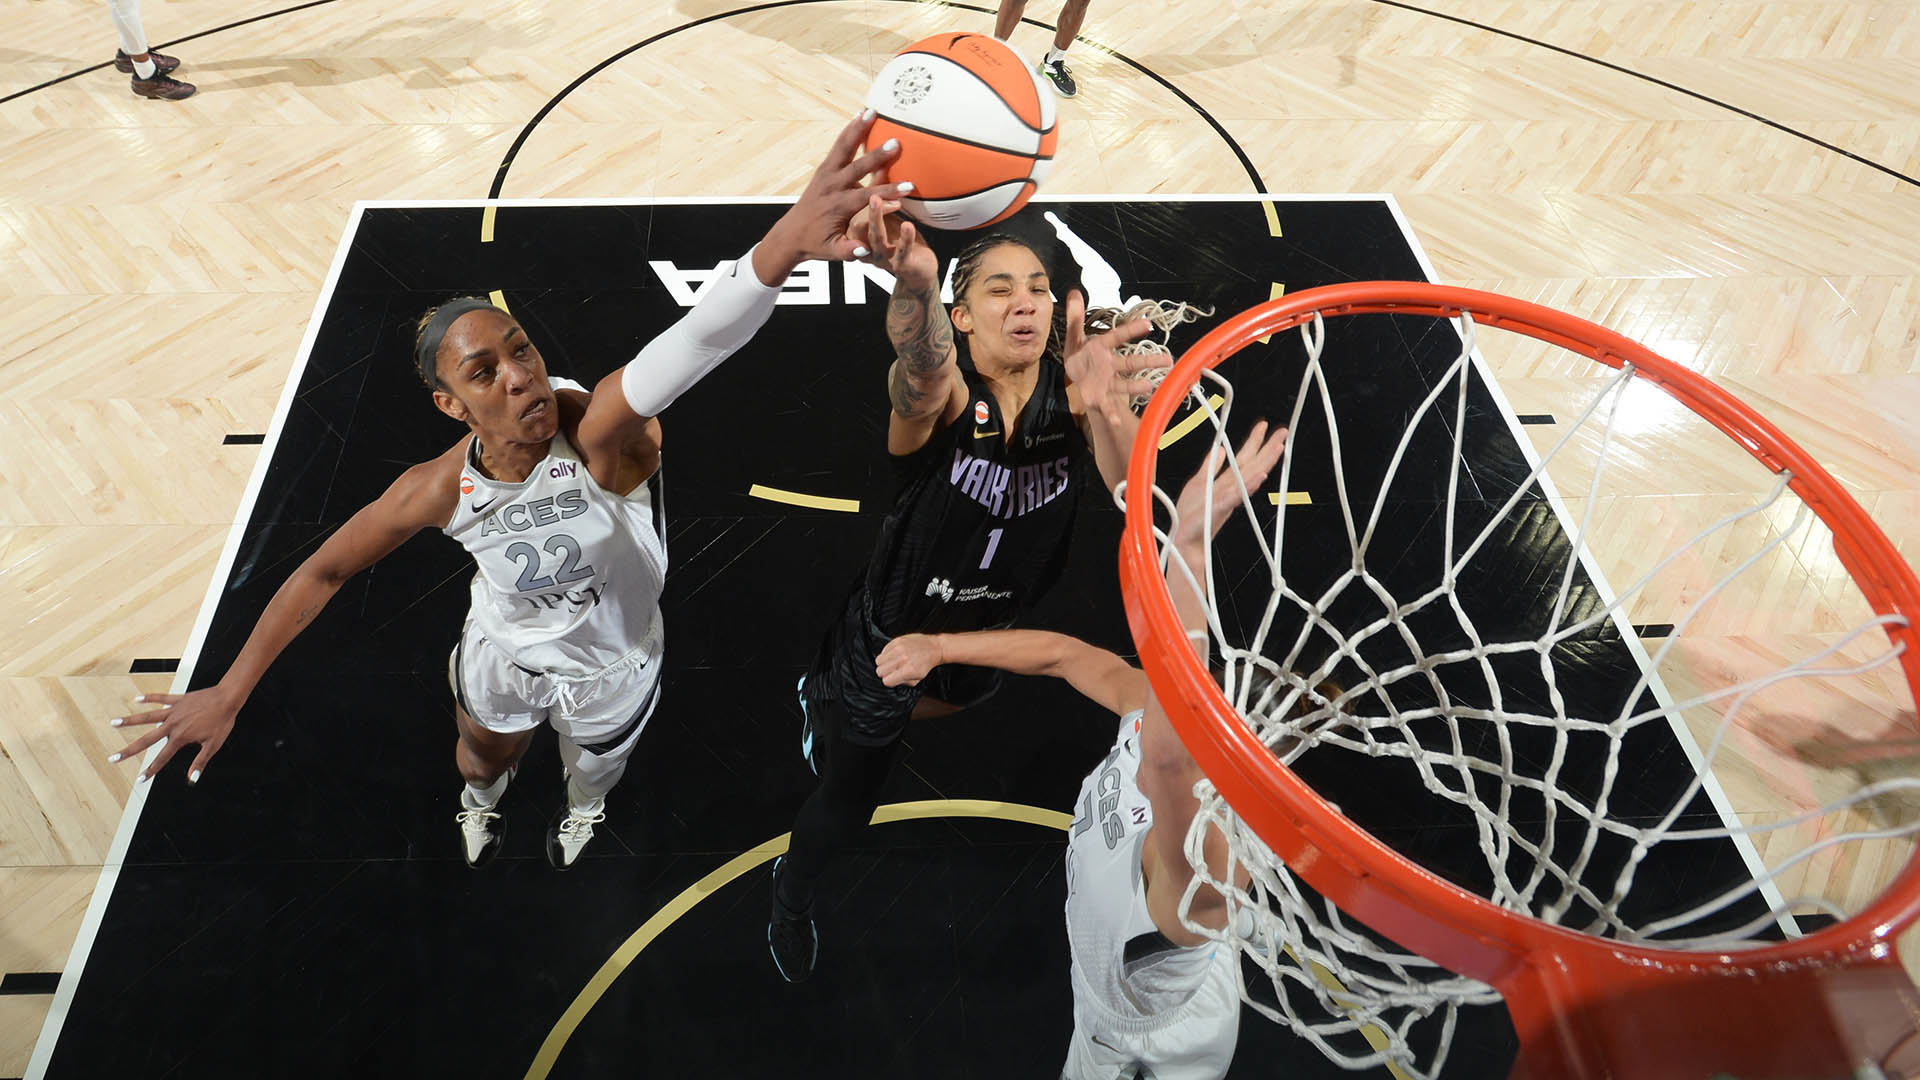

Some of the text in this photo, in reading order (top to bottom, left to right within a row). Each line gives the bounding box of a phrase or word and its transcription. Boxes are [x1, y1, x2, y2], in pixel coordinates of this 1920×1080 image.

[550, 461, 577, 479] ally
[481, 489, 589, 537] ACES
[505, 534, 596, 592] 22
[979, 528, 1004, 570] 1
[959, 585, 989, 596] KAISER
